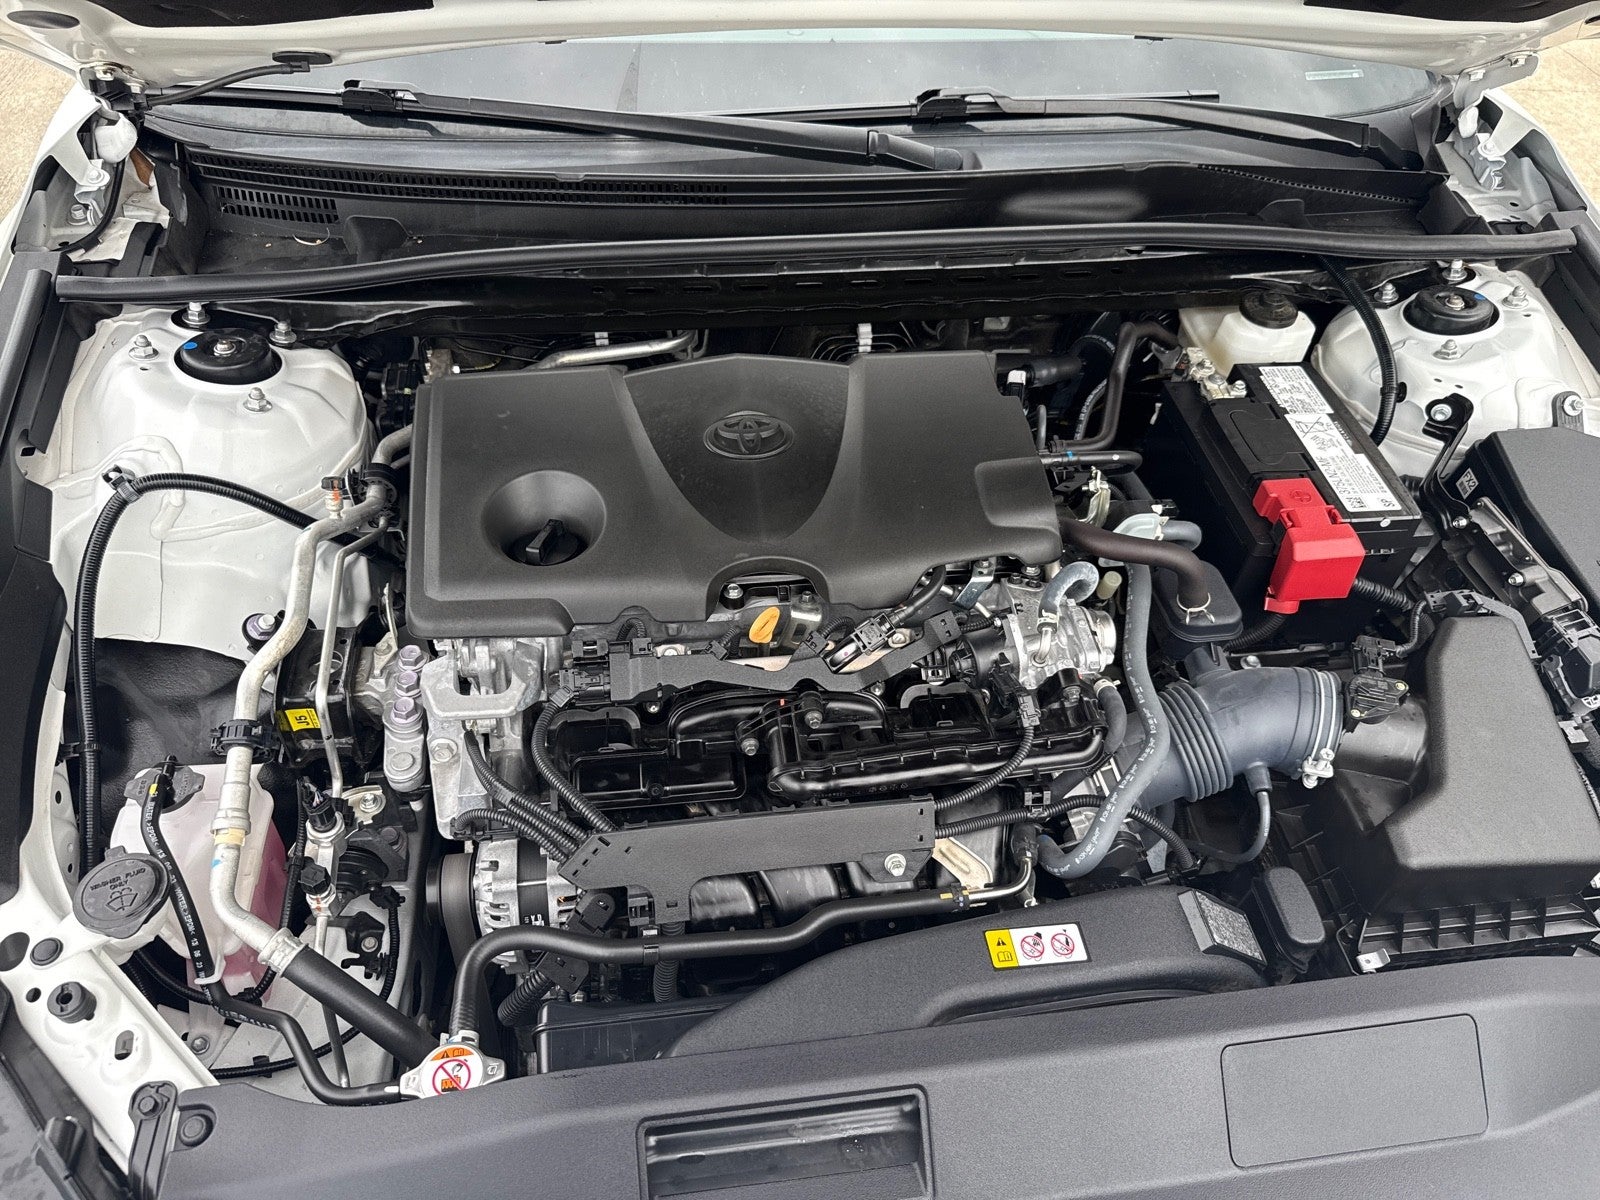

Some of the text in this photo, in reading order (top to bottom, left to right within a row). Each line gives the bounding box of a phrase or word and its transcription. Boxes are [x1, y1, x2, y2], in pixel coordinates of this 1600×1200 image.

[1462, 470, 1477, 491] FX2
[109, 879, 129, 891] ONLY
[174, 886, 187, 910] WATER
